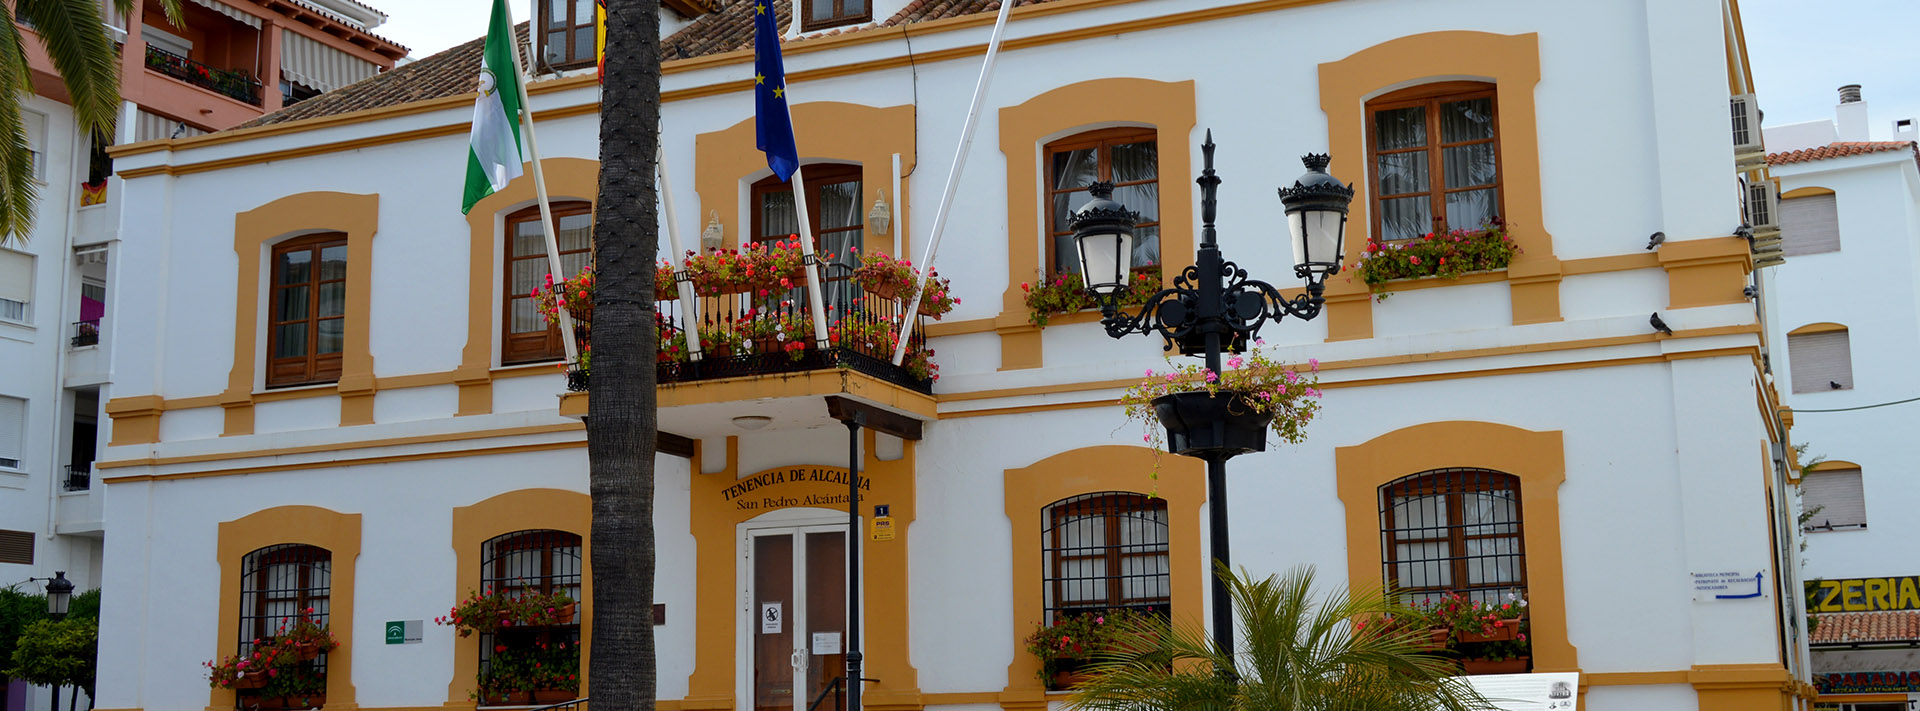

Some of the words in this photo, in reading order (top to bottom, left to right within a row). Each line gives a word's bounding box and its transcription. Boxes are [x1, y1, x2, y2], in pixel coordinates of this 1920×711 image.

[721, 471, 784, 501] TENENCIA
[790, 469, 806, 482] DE
[810, 469, 871, 491] ALCALIA
[737, 499, 758, 511] San
[763, 496, 799, 509] Pedro
[803, 493, 865, 506] Alcántaa
[880, 507, 884, 515] 1
